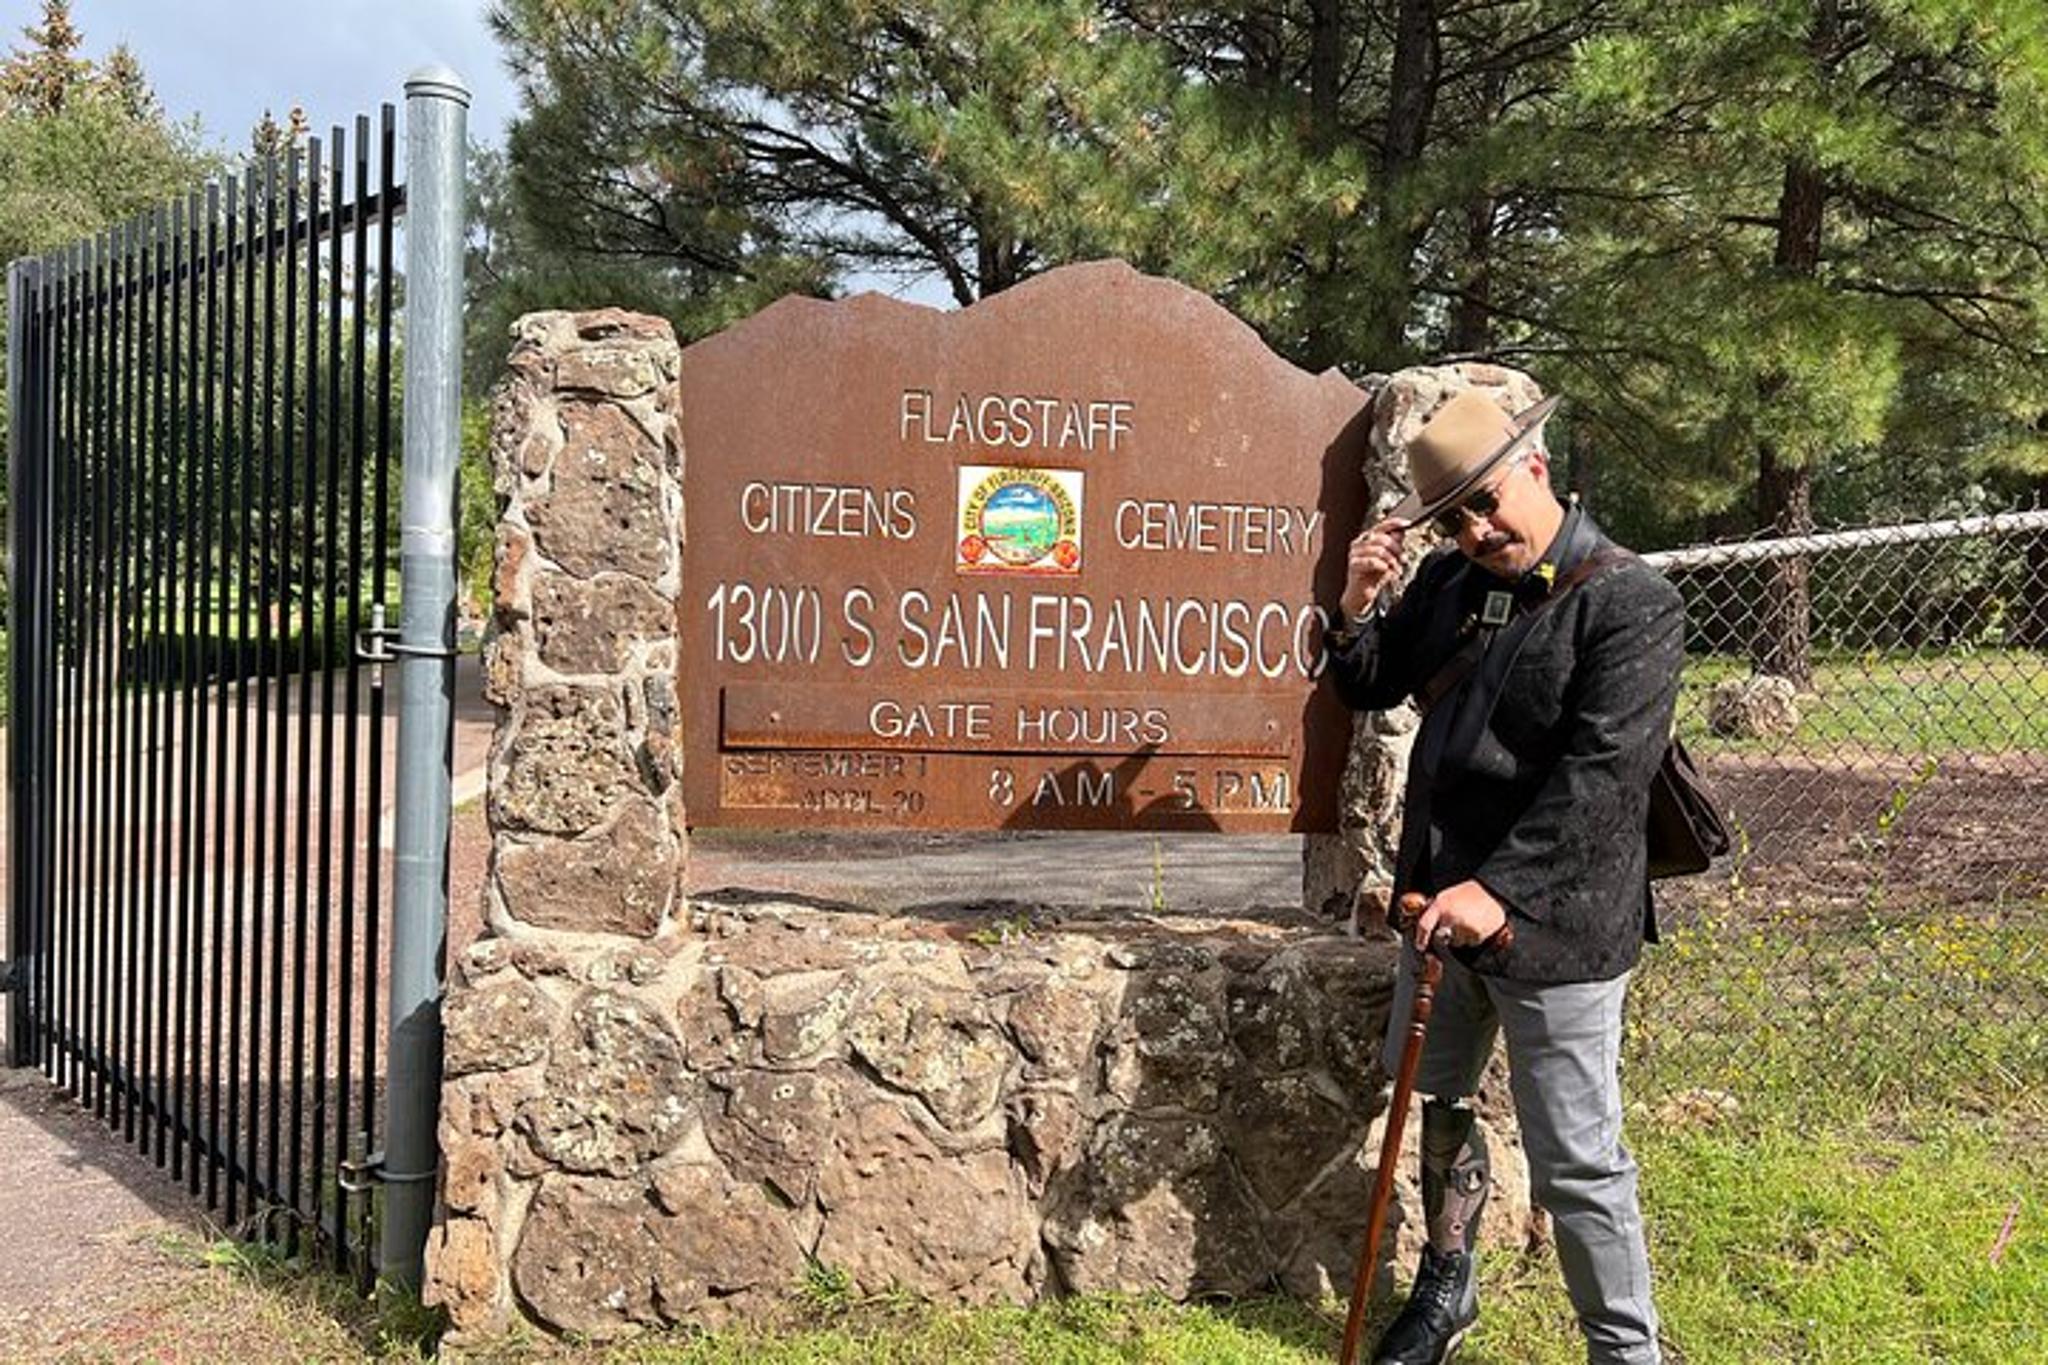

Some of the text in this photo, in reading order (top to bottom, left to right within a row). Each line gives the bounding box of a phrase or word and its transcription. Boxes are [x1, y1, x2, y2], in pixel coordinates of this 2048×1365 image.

[900, 390, 1134, 451] FLAGSTAFF
[740, 481, 1325, 554] CITIZENS CEMETERY
[707, 582, 1330, 679] 1300 S SAN FRANCISCO
[869, 701, 1170, 746] GATE HOURS
[988, 768, 1015, 808] 8
[1171, 770, 1197, 811] 5
